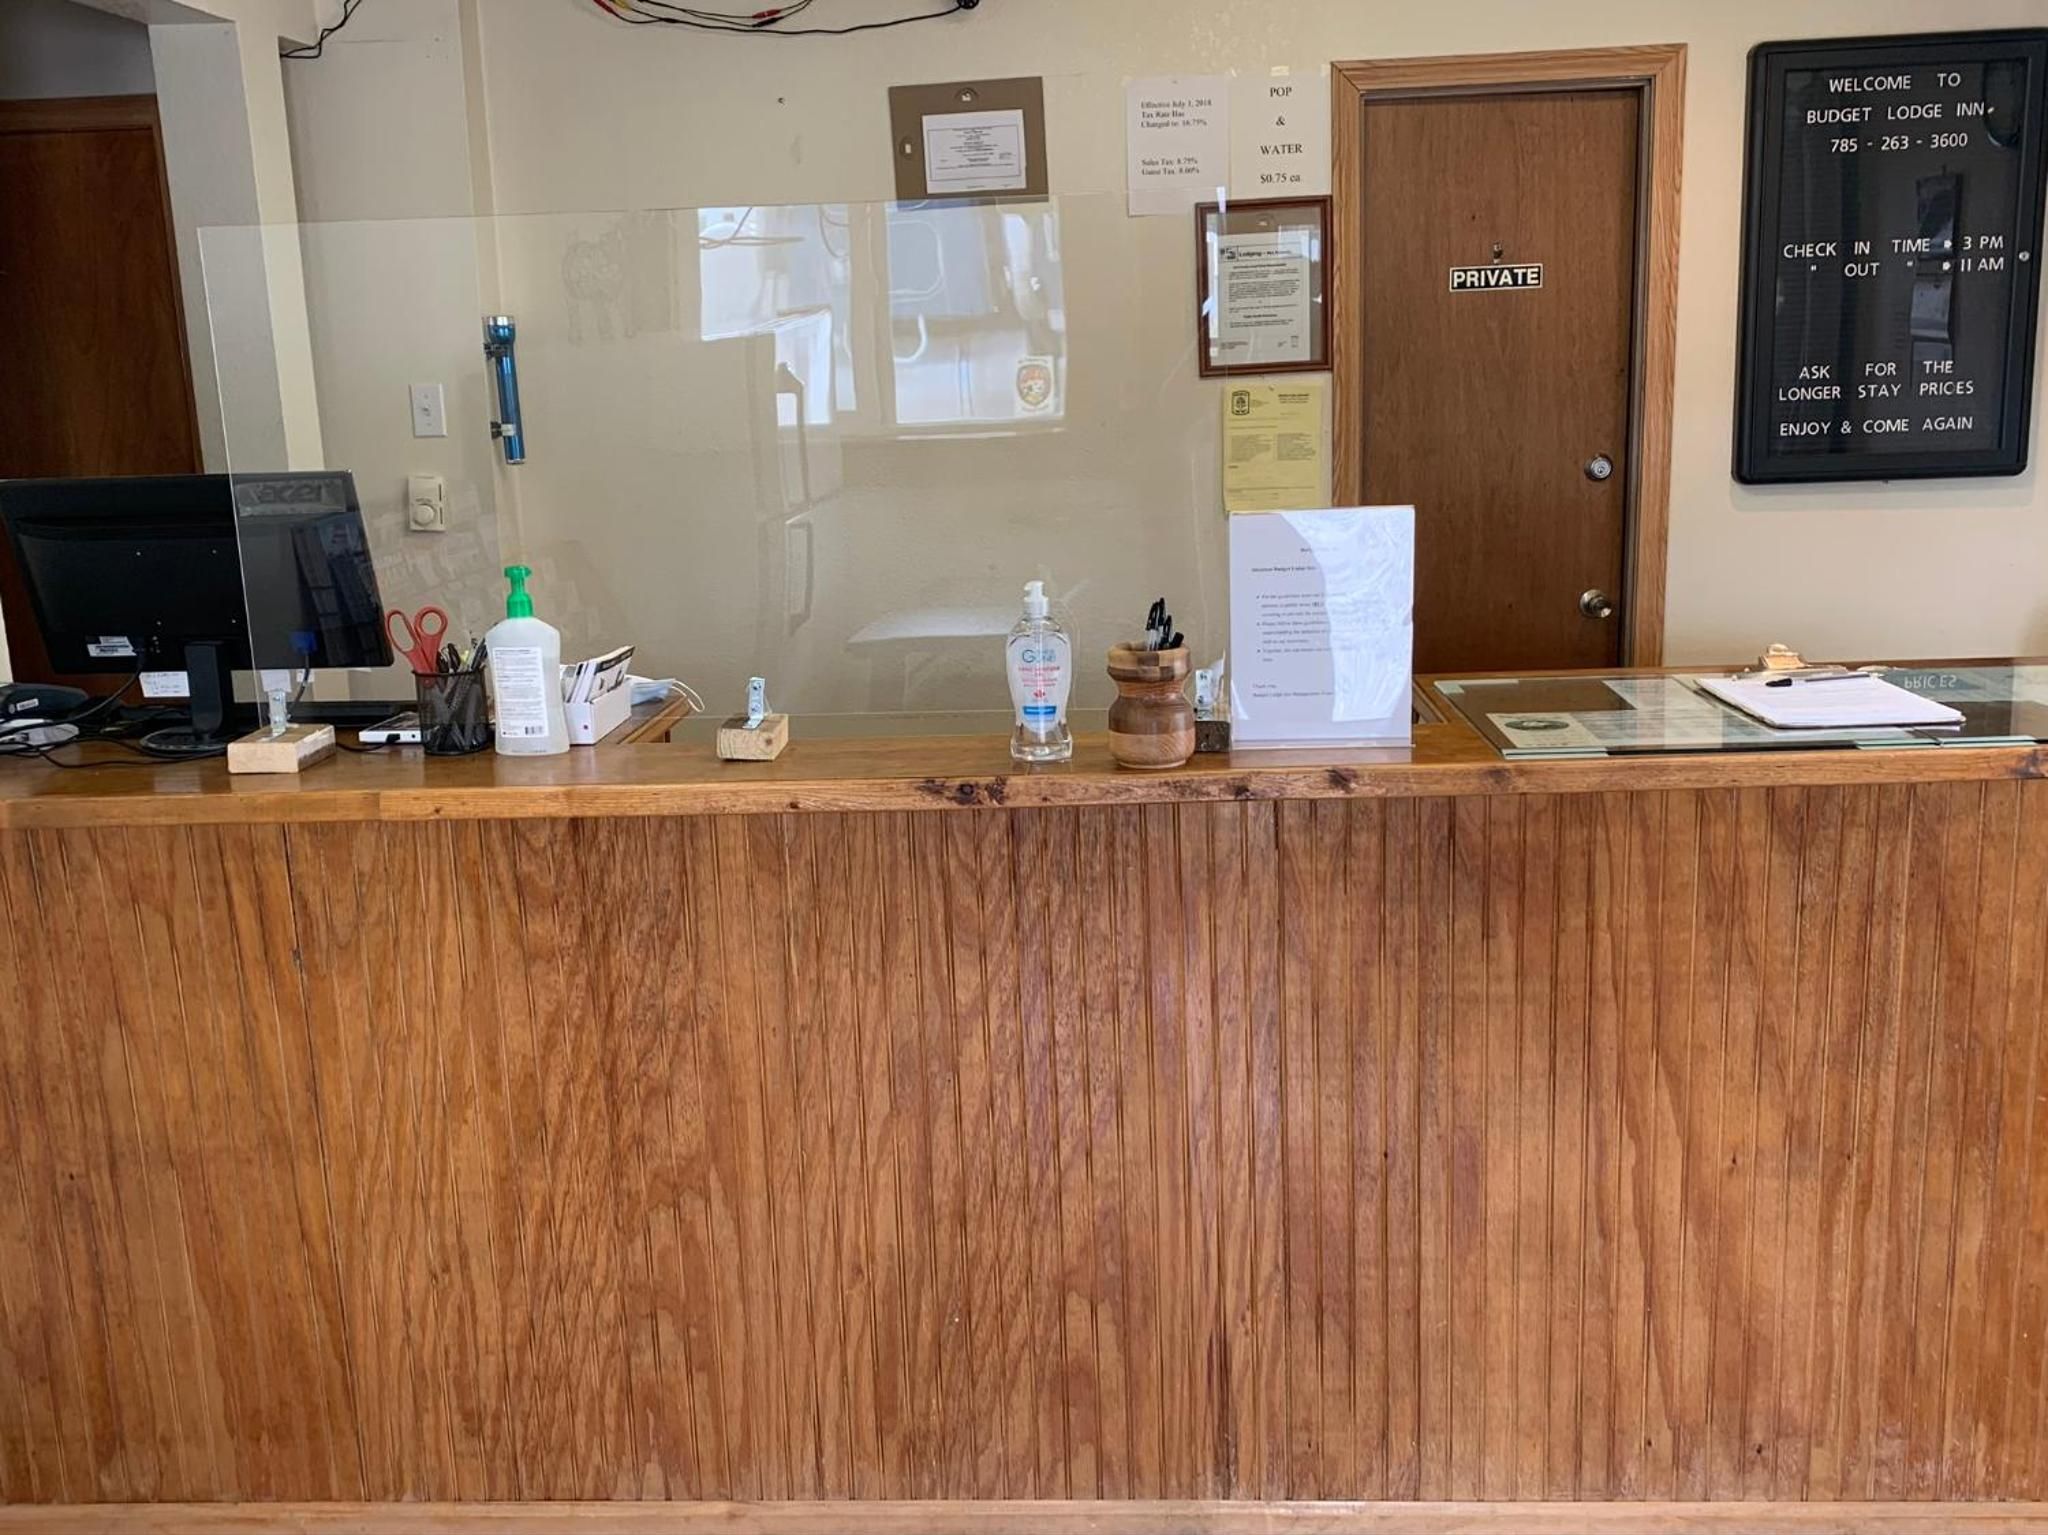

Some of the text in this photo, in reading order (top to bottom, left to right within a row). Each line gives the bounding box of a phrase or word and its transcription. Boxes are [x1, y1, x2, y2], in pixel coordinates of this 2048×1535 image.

[1269, 86, 1293, 98] POP
[1829, 72, 1962, 93] WELCOME TO
[1275, 115, 1286, 127] &
[1806, 101, 1985, 124] BUDGET LODGE INN
[1260, 144, 1303, 156] WATER
[1830, 138, 1858, 153] 785
[1881, 135, 1910, 151] 263
[1930, 132, 1969, 149] 3600
[1260, 173, 1287, 184] $0.75
[1783, 235, 2004, 259] CHECK IN TIME 3 PM
[1844, 262, 1880, 277] OUT
[1961, 258, 1972, 273] 11
[1977, 256, 2004, 272] AM
[1453, 267, 1540, 288] PRIVATE
[1799, 360, 1954, 380] ASK FOR THE
[1778, 380, 1975, 402] LONGER STAY PRICES
[1779, 416, 1974, 437] ENJOY & COME AGAIN
